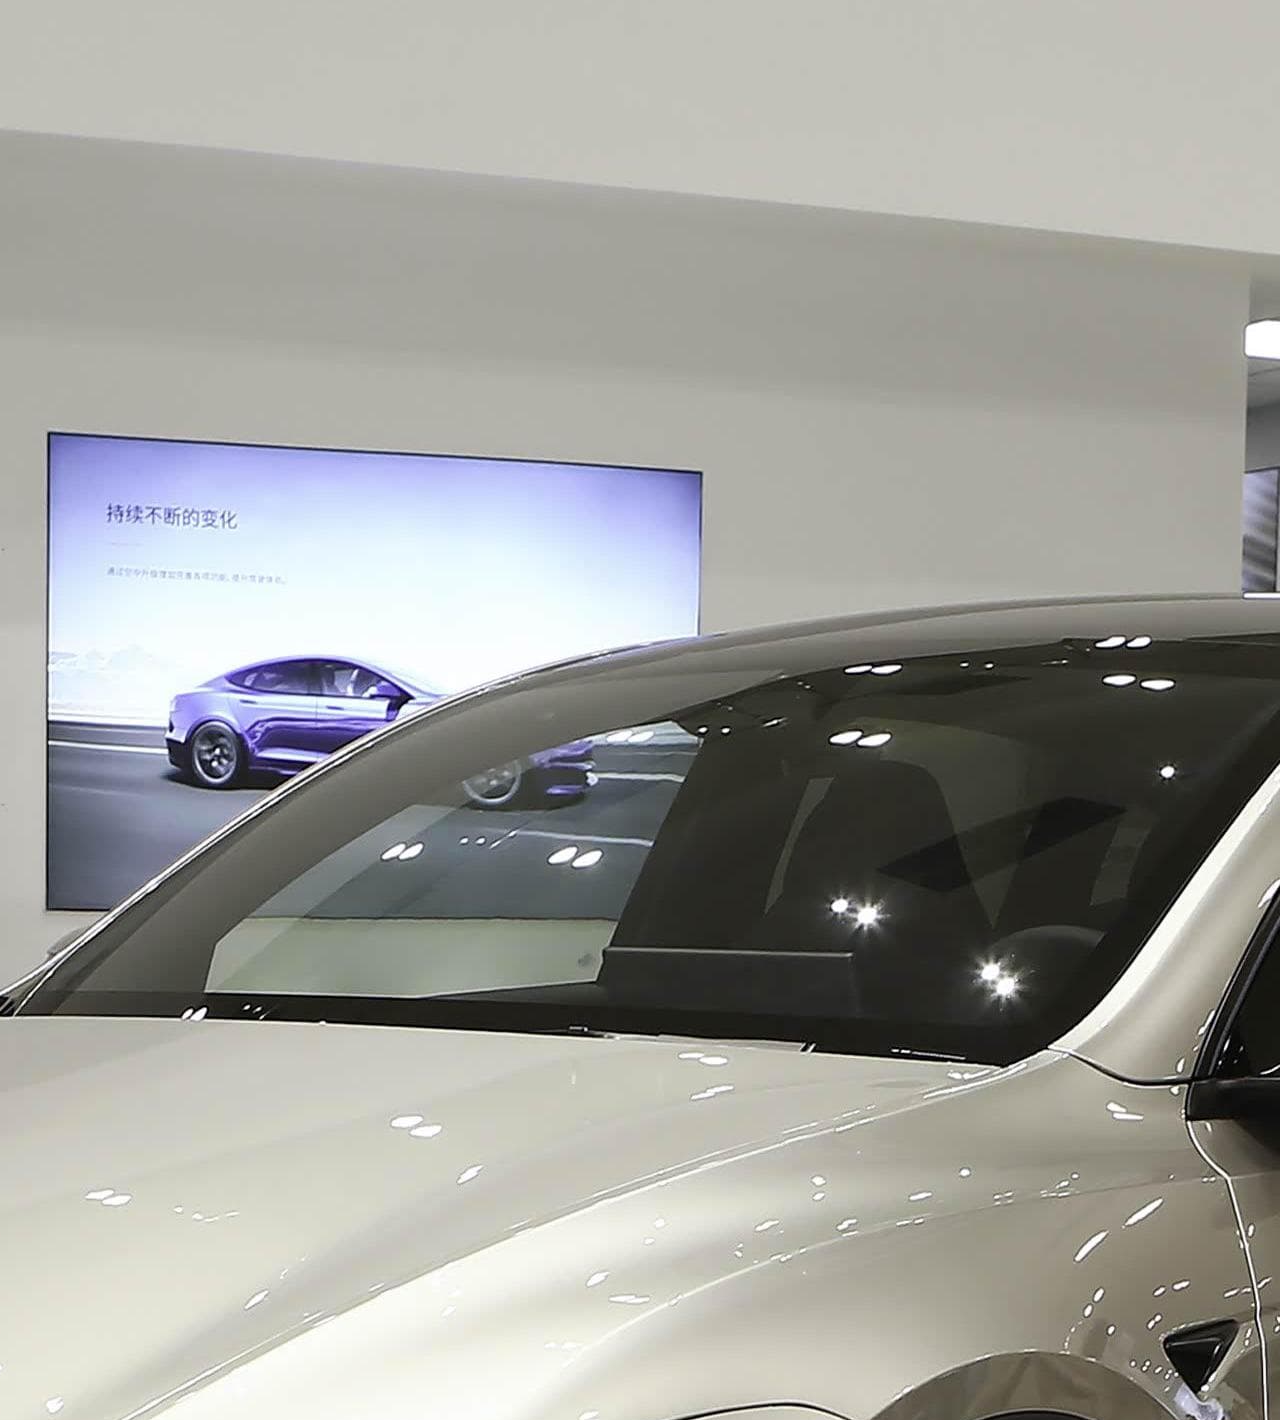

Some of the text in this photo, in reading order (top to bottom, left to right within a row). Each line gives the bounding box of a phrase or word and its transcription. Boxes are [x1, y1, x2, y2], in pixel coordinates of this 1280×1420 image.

[107, 503, 237, 529] 持续不断的变化
